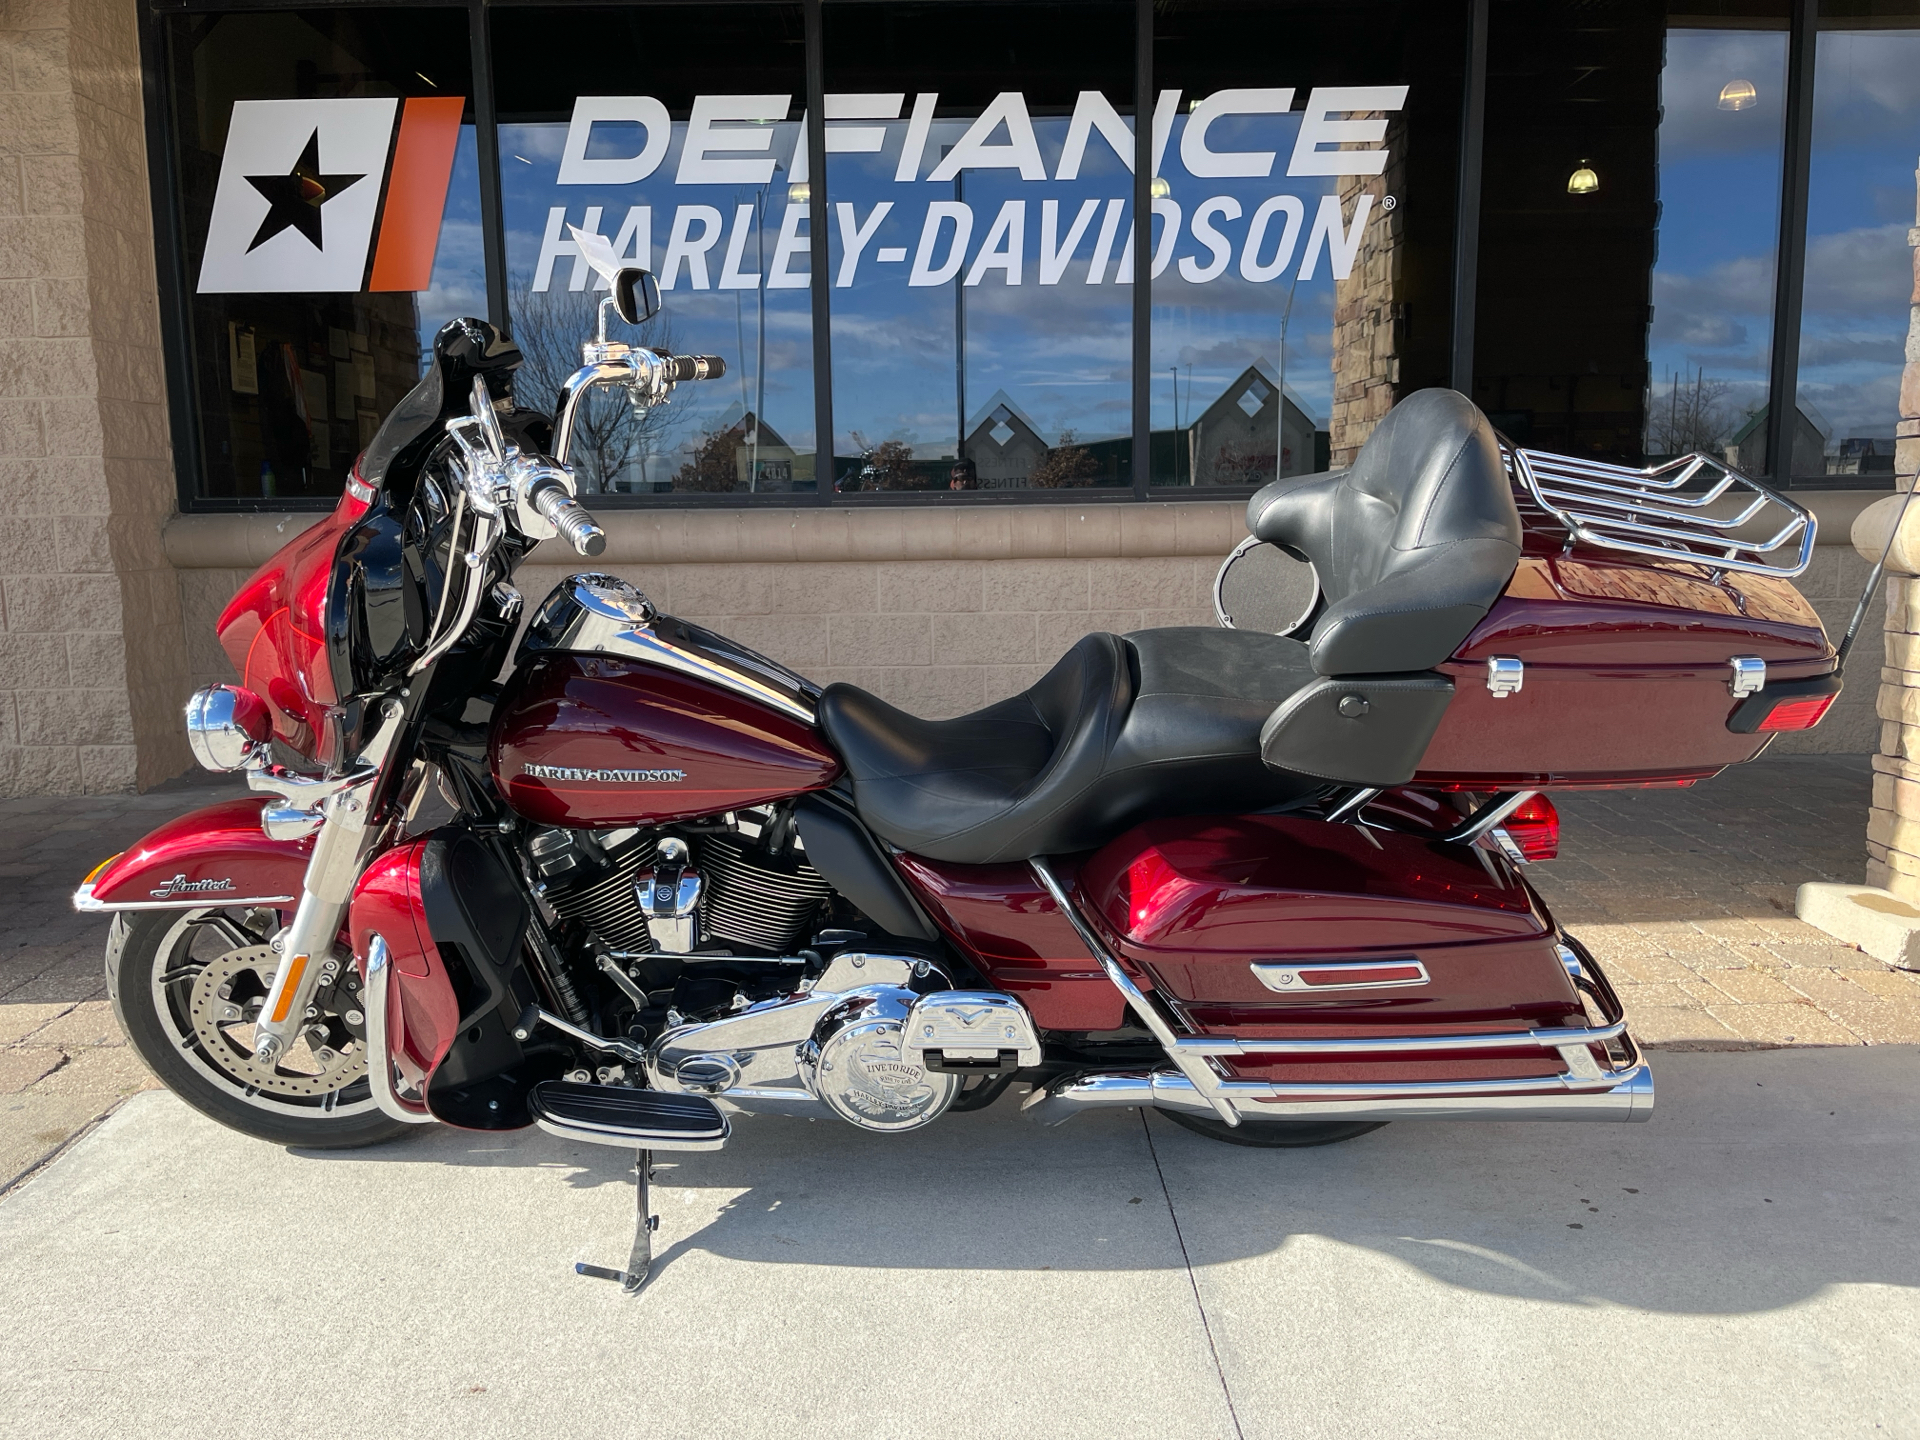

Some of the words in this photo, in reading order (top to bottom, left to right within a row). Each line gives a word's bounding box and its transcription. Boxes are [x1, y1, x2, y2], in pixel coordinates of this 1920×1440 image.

[556, 85, 1410, 185] DEFIANCE
[524, 762, 683, 782] HARLEY-DAVIDSON
[149, 873, 236, 898] Limited
[866, 1063, 887, 1073] LIVE
[887, 1063, 899, 1072] TO
[900, 1064, 921, 1080] RIDE
